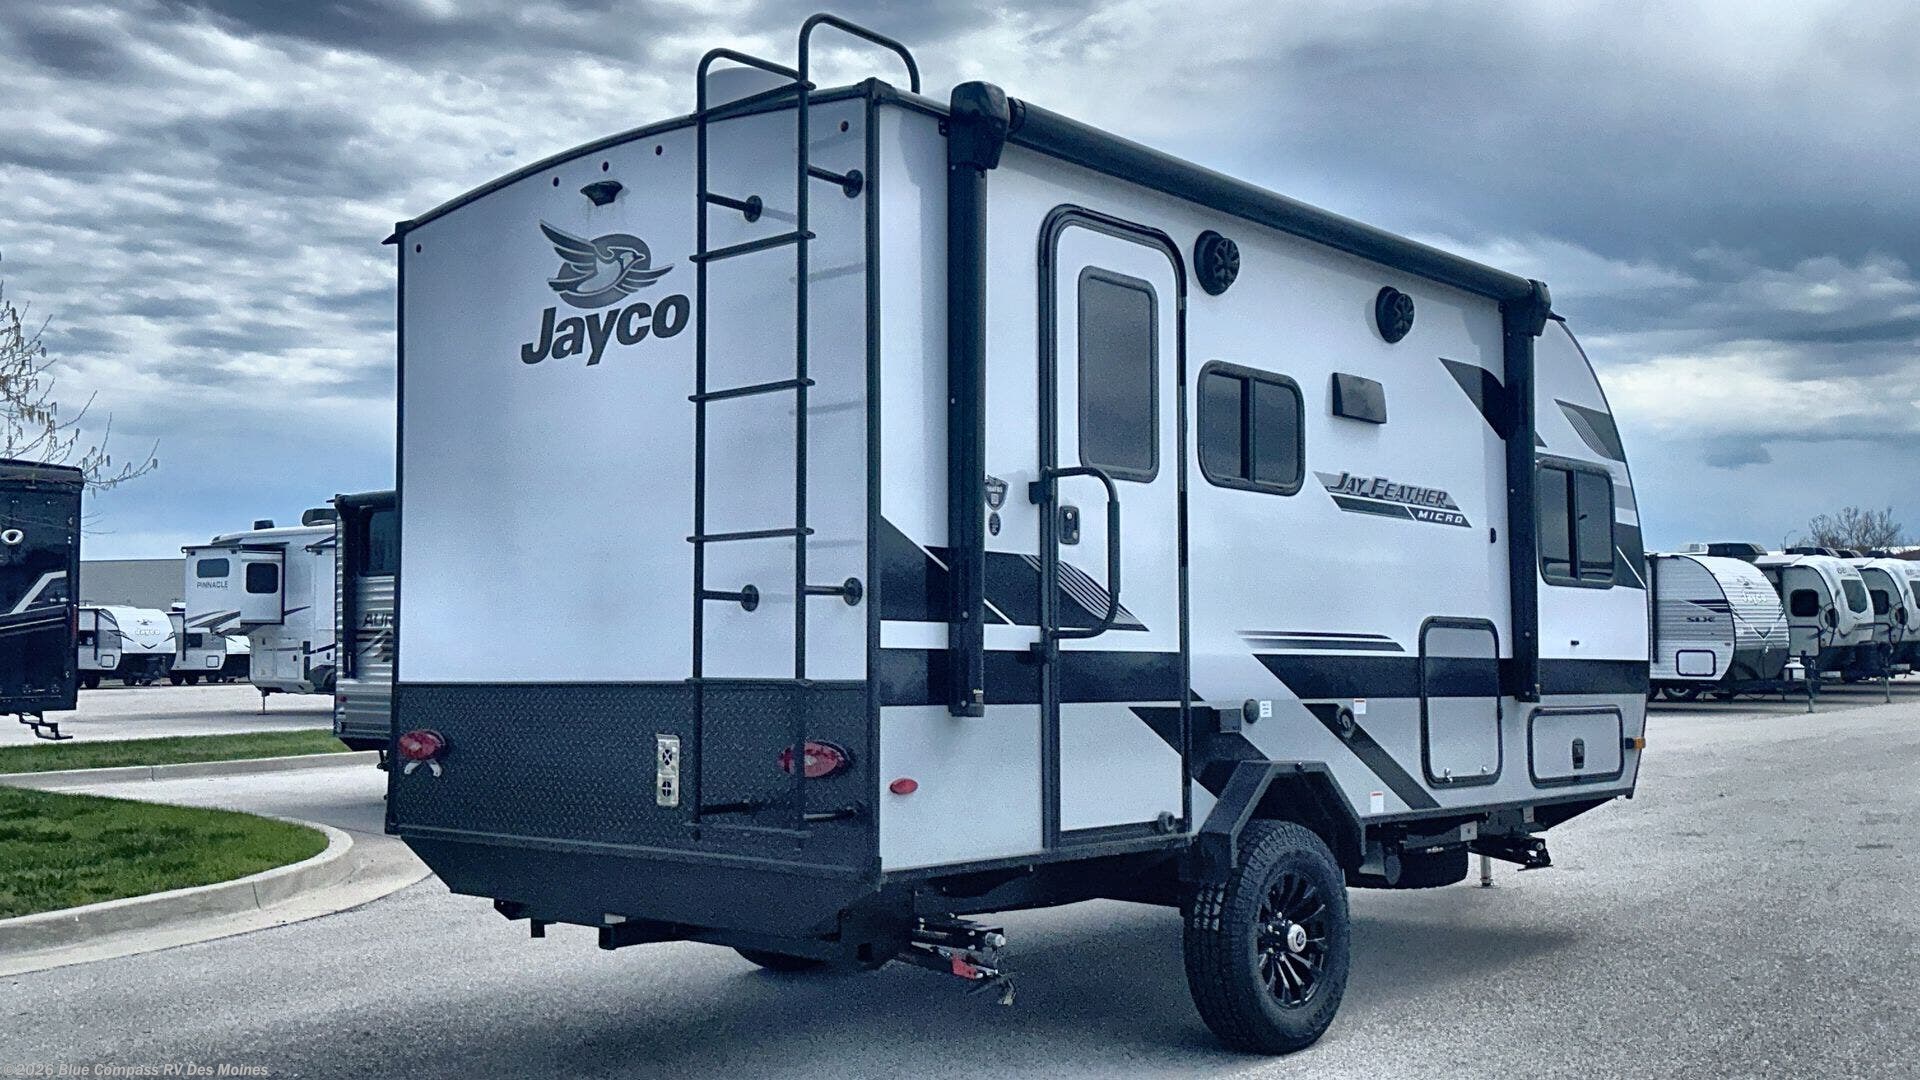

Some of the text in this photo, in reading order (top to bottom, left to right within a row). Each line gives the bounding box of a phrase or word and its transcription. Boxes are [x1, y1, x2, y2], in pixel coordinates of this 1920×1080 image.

[521, 294, 690, 366] Jayco
[1329, 472, 1448, 507] JAY FEATHER
[1418, 510, 1464, 524] MICRO
[196, 580, 229, 589] PINNACLE
